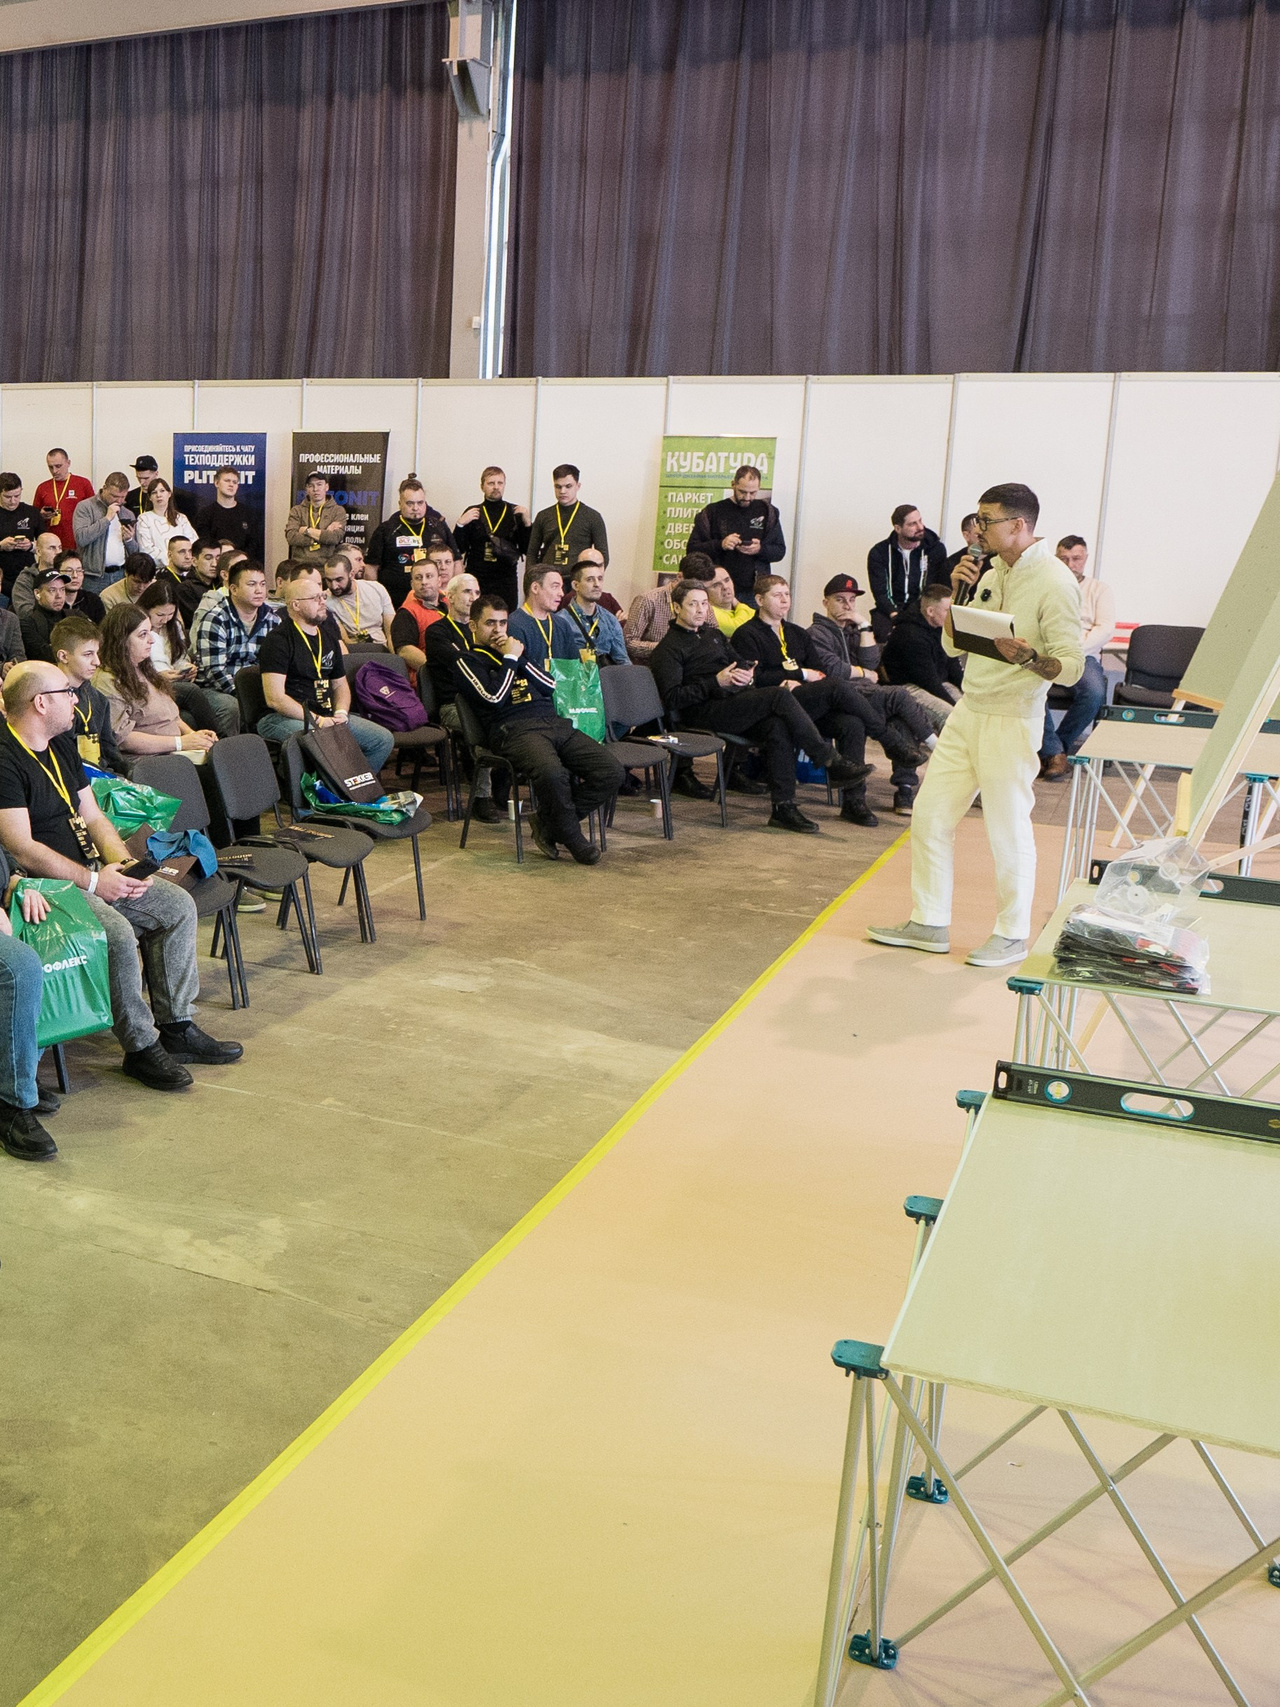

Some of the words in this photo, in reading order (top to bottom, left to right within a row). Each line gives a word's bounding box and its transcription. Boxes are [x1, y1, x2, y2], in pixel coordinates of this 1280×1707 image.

[184, 454, 255, 466] ТЕХПОДДЕРЖКИ
[299, 453, 381, 463] ПРОФЕССИОНАЛЬНЫЕ
[666, 452, 768, 474] КУБАТУРА
[317, 465, 362, 474] МАТЕРИАЛЫ
[184, 470, 256, 484] PLITIT
[668, 492, 714, 503] ПАРКЕТ
[666, 508, 702, 518] ПЛИТ
[41, 955, 88, 973] ОФЛЕКС
